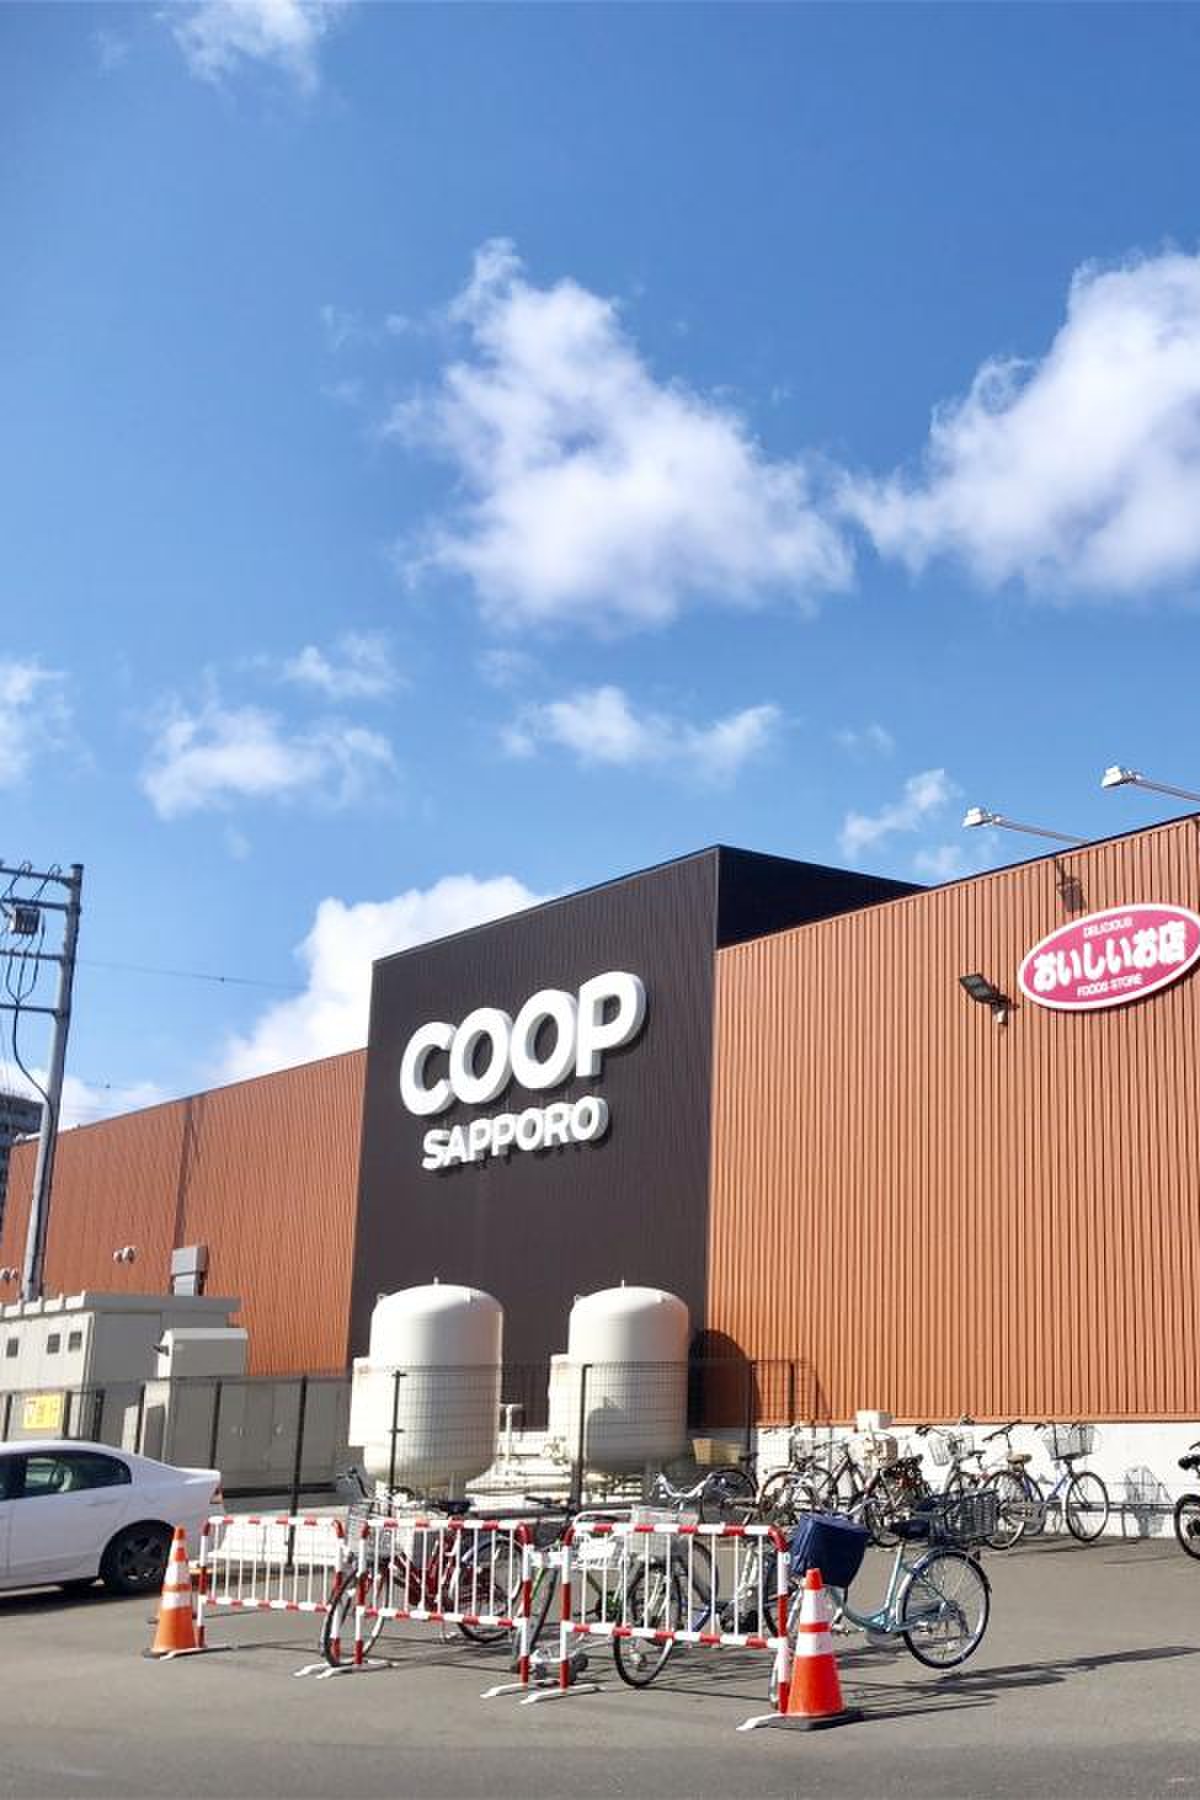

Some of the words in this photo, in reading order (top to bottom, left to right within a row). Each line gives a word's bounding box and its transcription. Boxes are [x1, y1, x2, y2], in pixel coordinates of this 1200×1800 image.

[1033, 920, 1186, 992] おいしいお店
[400, 971, 646, 1115] COOP
[422, 1096, 608, 1170] SAPPORO
